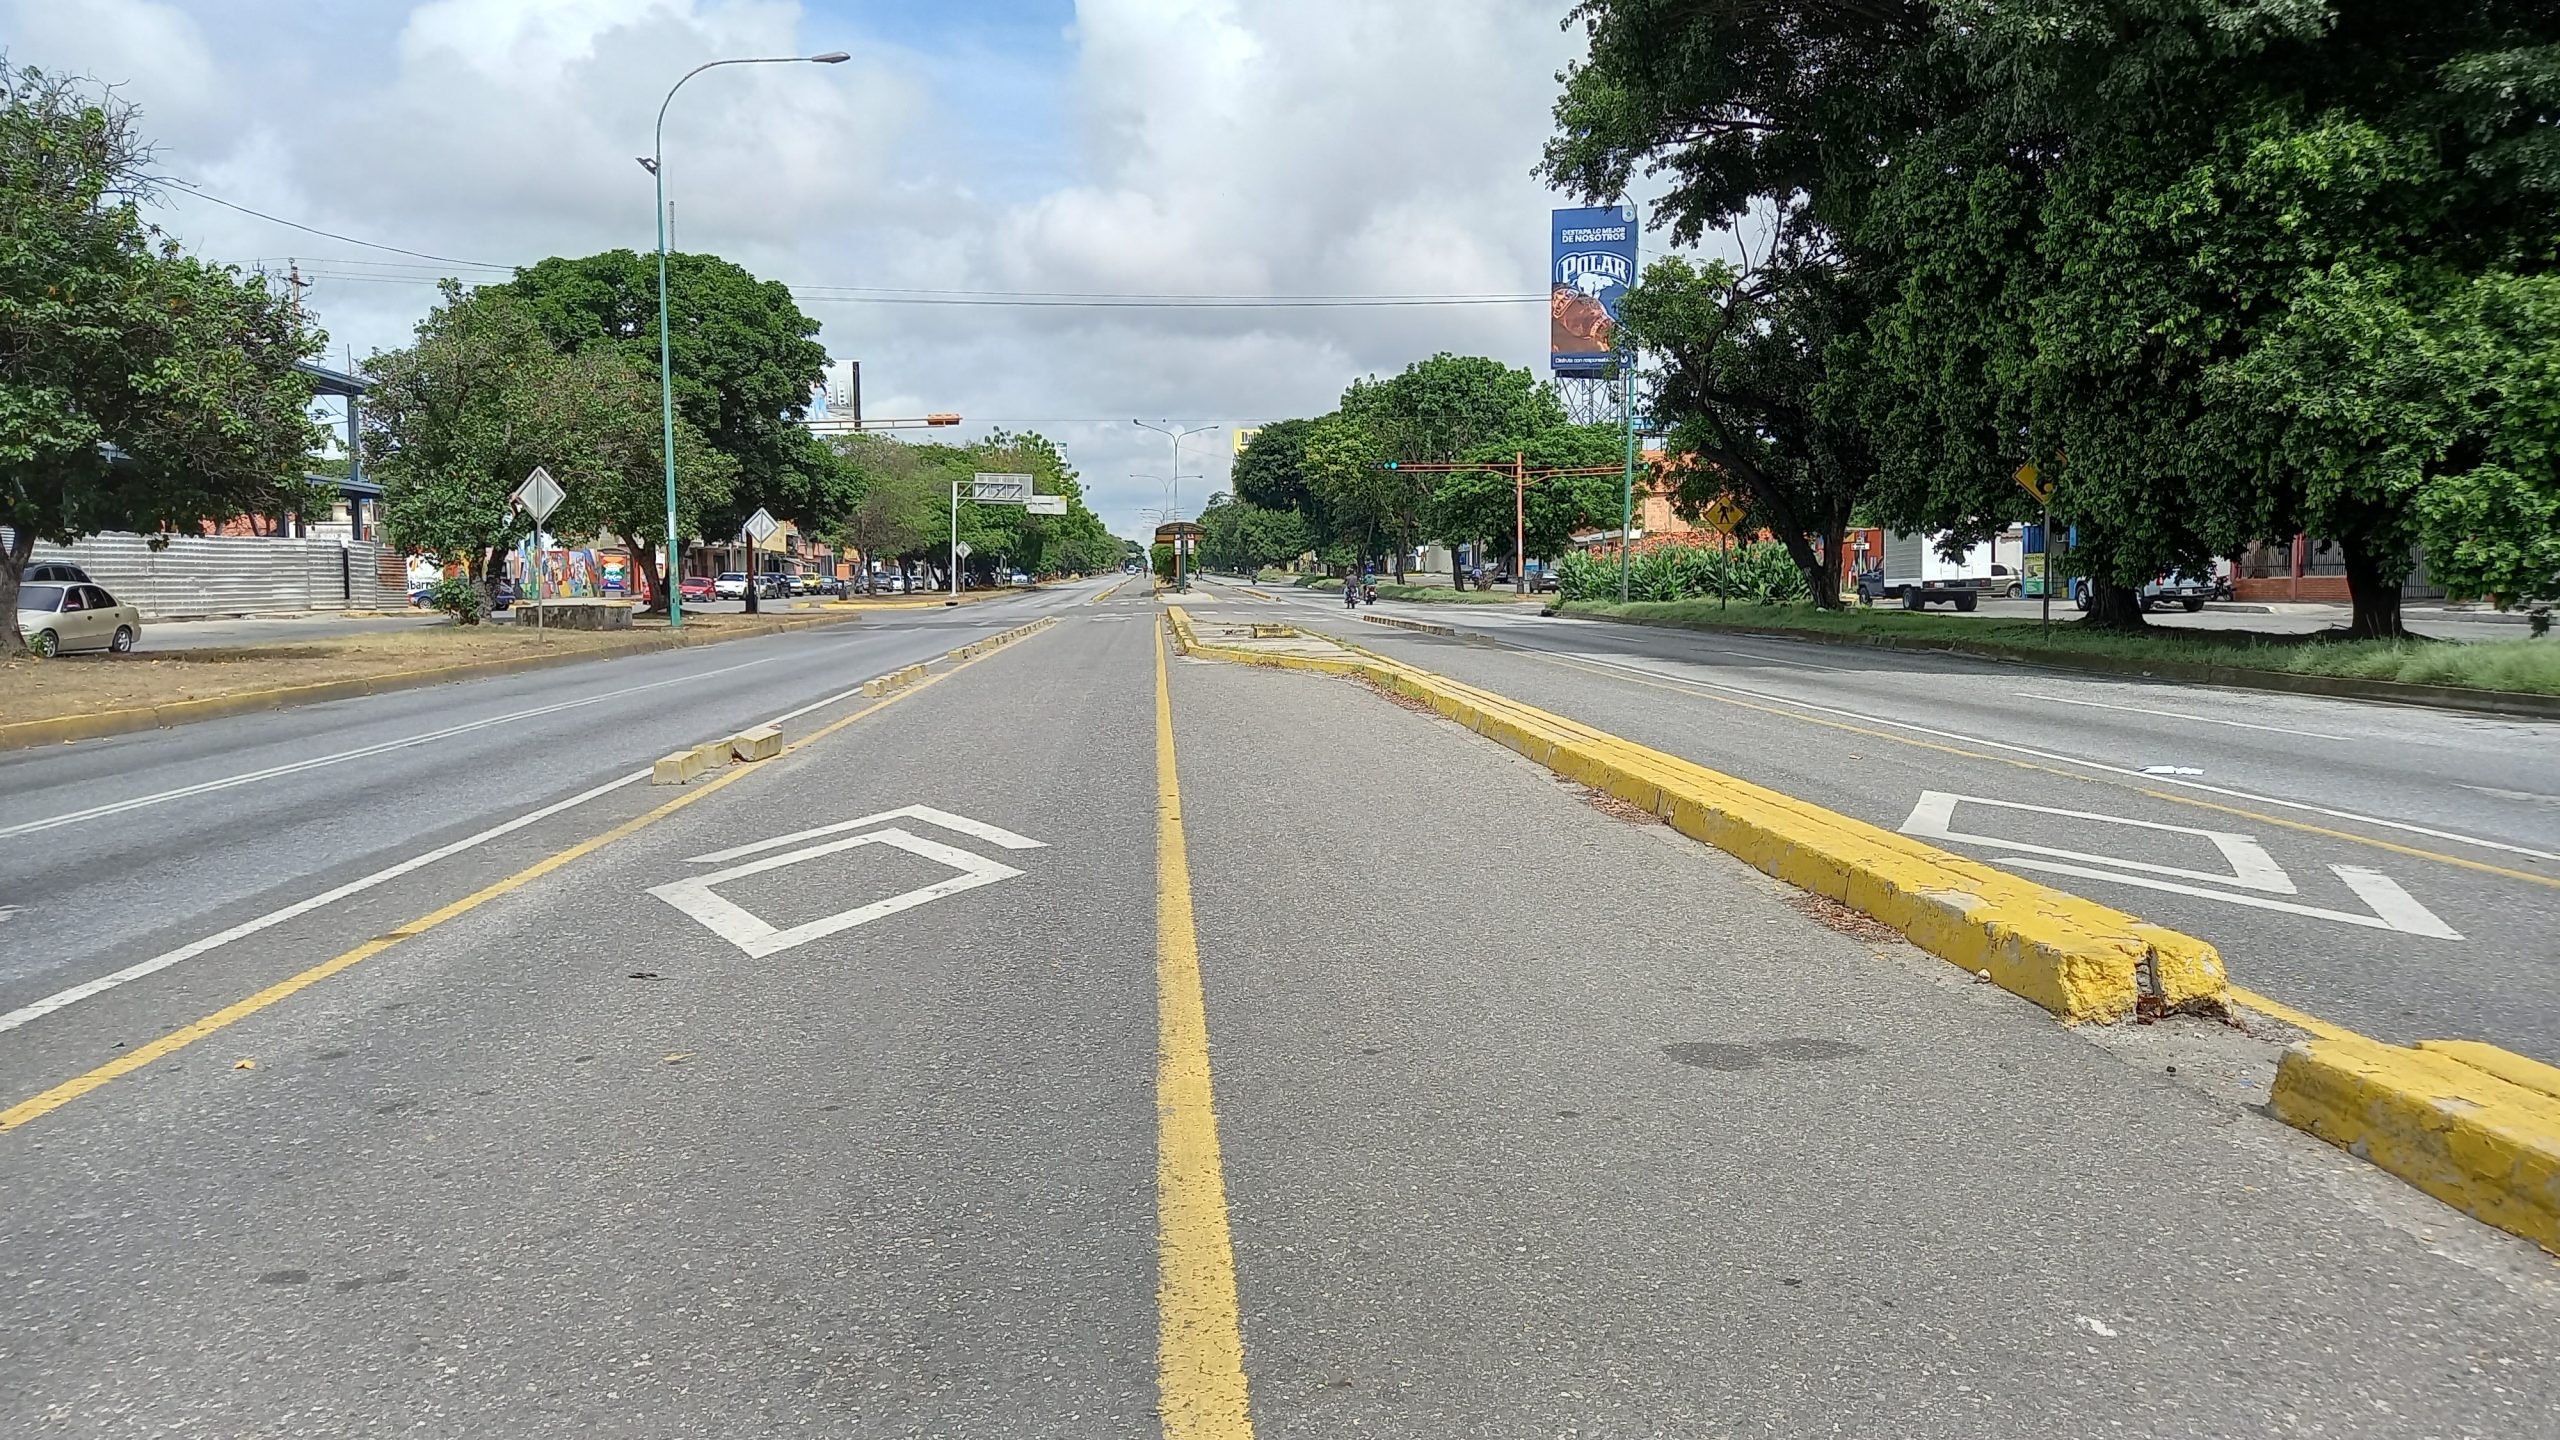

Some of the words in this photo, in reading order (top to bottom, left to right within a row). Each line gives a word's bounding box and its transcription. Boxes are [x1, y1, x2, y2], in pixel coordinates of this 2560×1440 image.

[1562, 228, 1591, 236] DESTAPA
[1562, 235, 1574, 243] DE
[1575, 233, 1626, 242] NOSOTROS
[1561, 255, 1628, 283] POLAR
